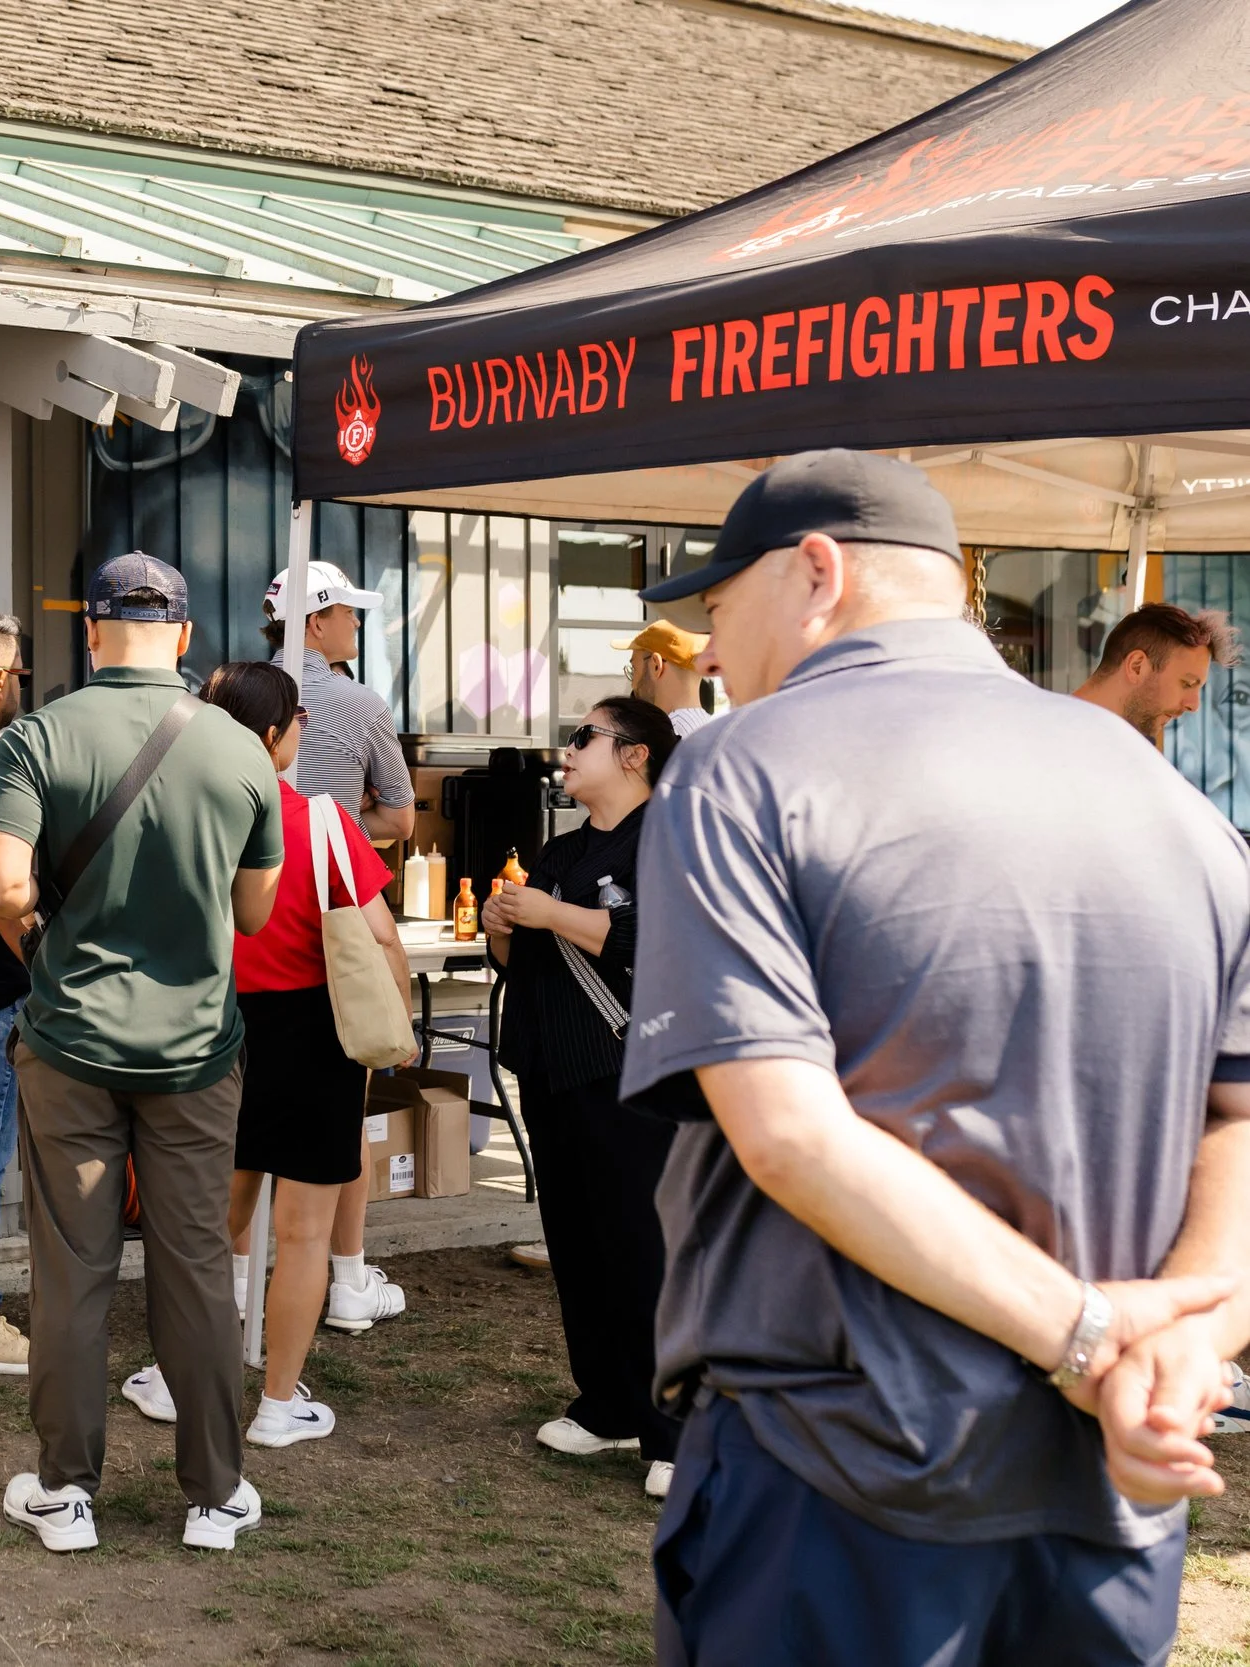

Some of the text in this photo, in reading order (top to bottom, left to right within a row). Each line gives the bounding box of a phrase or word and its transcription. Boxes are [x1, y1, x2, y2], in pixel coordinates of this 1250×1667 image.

[834, 178, 1168, 239] CHARITABLE
[427, 275, 1250, 431] BURNABY FIREFIGHTERS CHA
[317, 589, 329, 603] FJ
